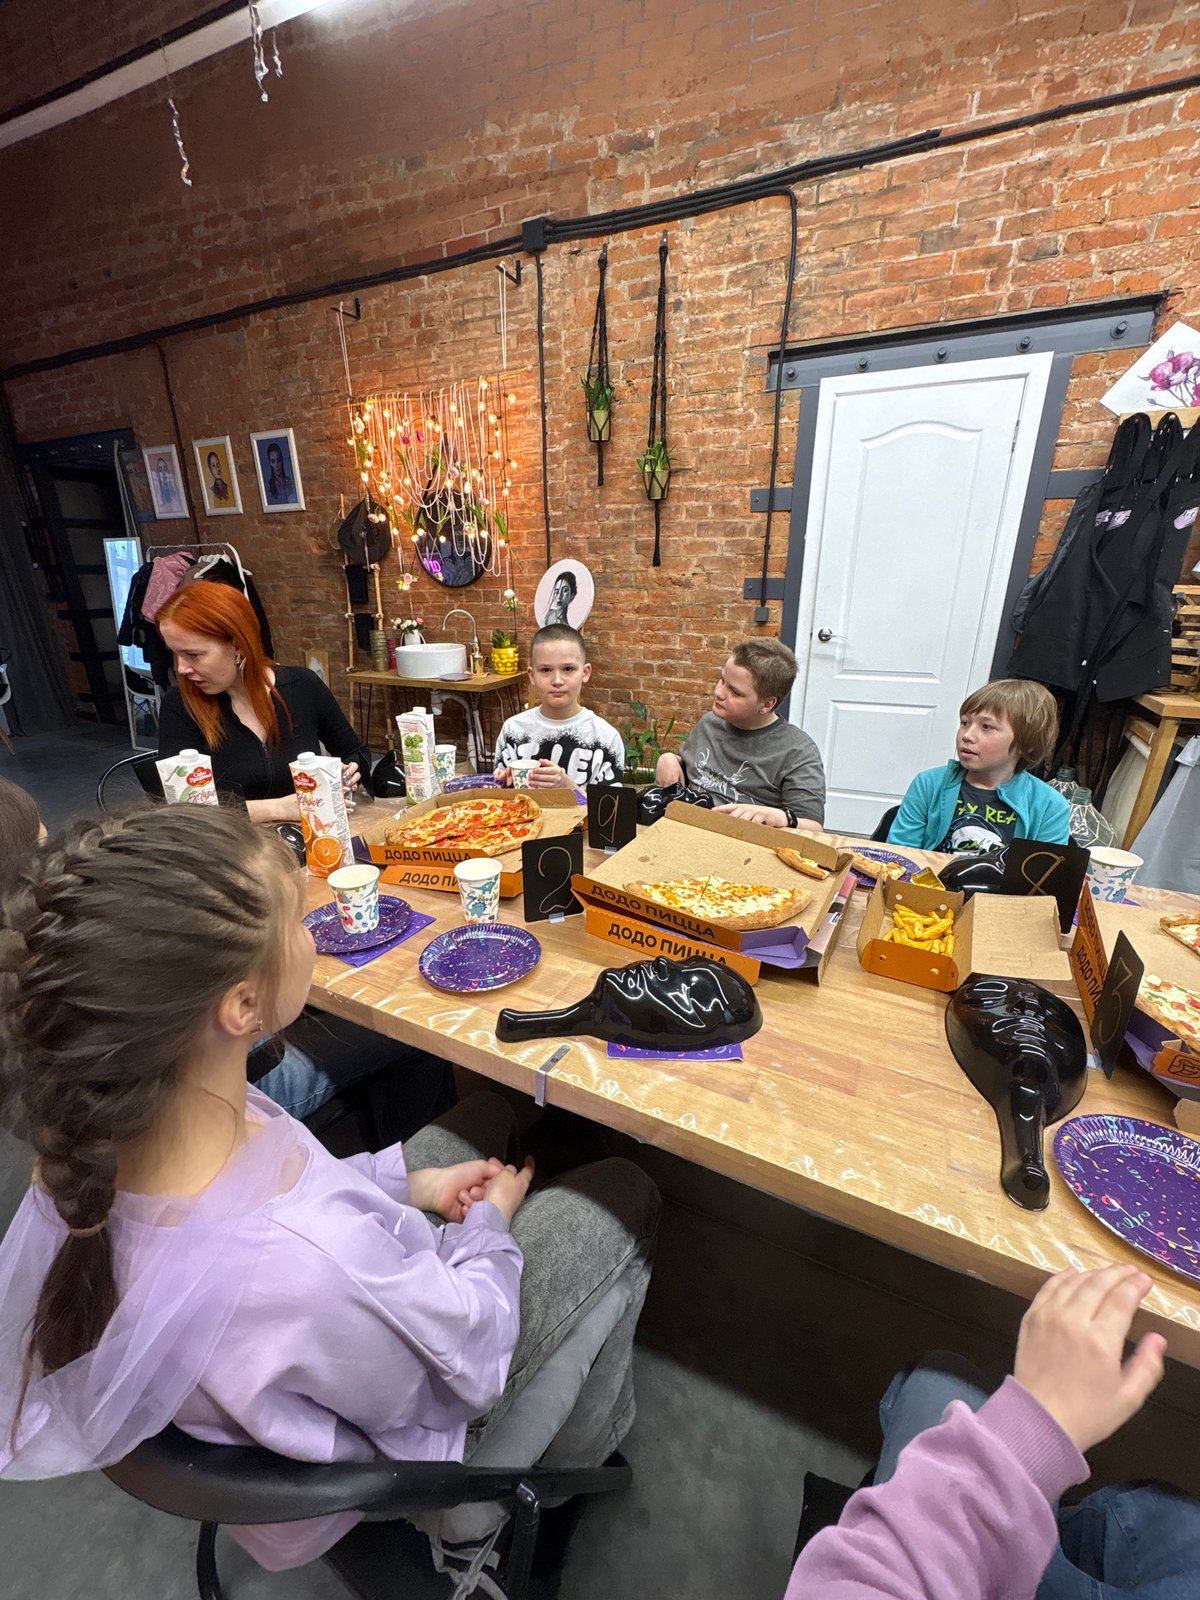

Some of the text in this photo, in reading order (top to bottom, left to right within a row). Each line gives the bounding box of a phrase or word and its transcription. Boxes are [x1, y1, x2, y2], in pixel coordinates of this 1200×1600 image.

[598, 794, 619, 843] 9
[384, 849, 421, 863] ДОДО
[399, 872, 440, 886] ДОДО
[538, 846, 575, 913] 2
[592, 885, 716, 939] ДОДО ПИЦЦА
[608, 923, 657, 947] ДОДО
[1077, 945, 1093, 981] ДОДО
